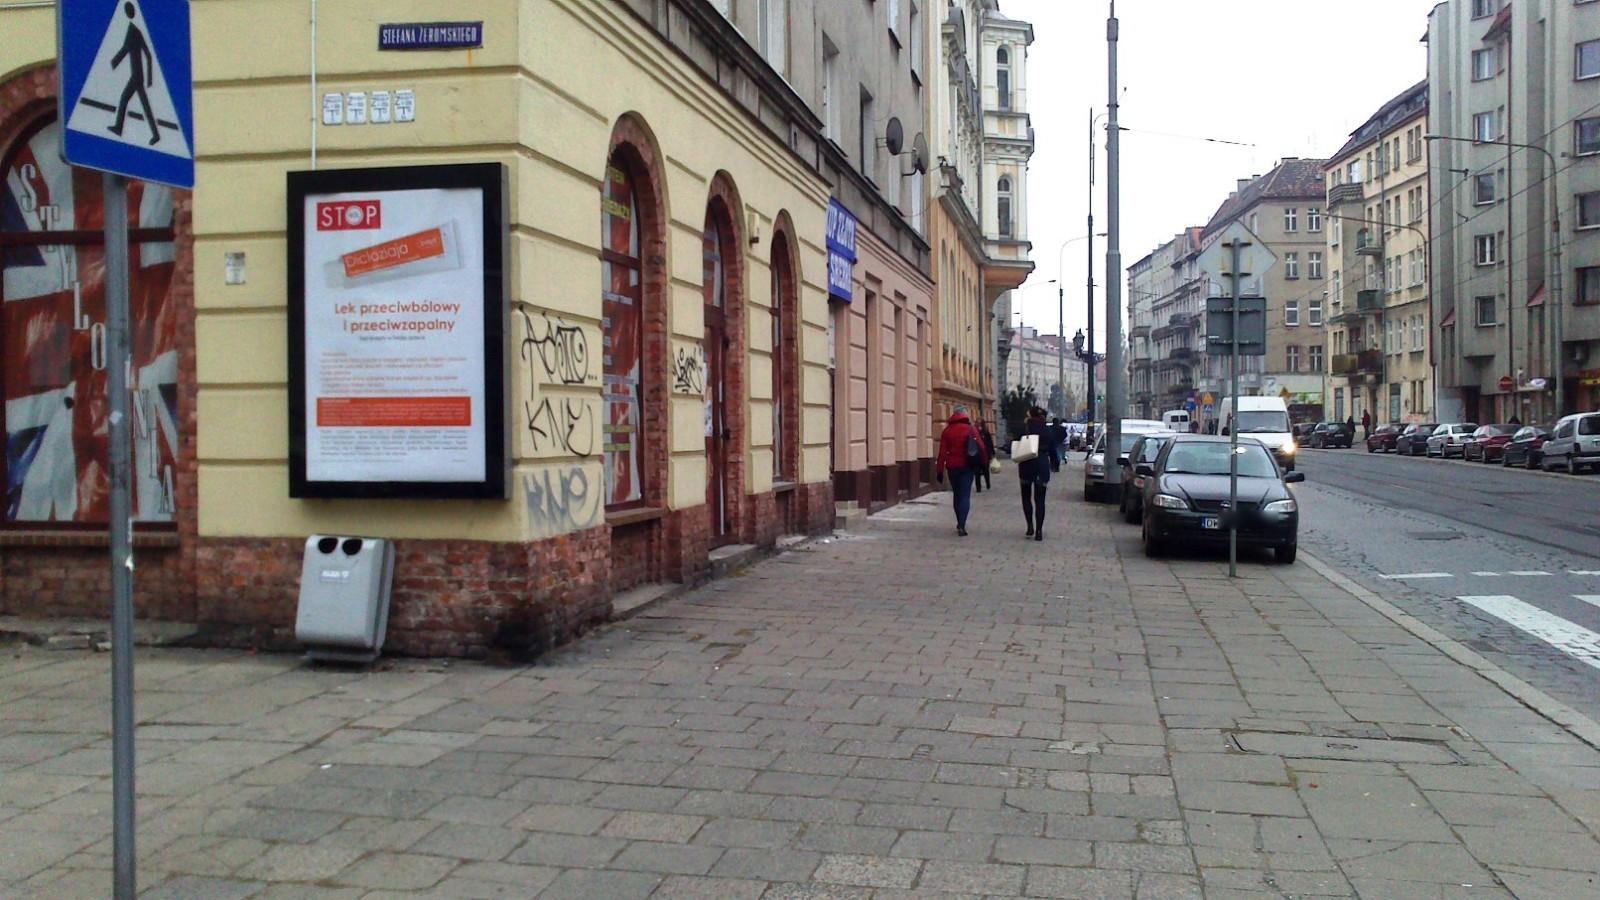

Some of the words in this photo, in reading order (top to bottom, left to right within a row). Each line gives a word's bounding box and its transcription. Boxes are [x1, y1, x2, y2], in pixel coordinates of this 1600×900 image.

[382, 28, 417, 45] STEFANA
[321, 205, 378, 227] STOP
[334, 302, 356, 315] Lek
[360, 300, 460, 317] przeciwbólowy
[350, 318, 456, 334] przeciwzapalny
[20, 163, 176, 514] STYLONIA
